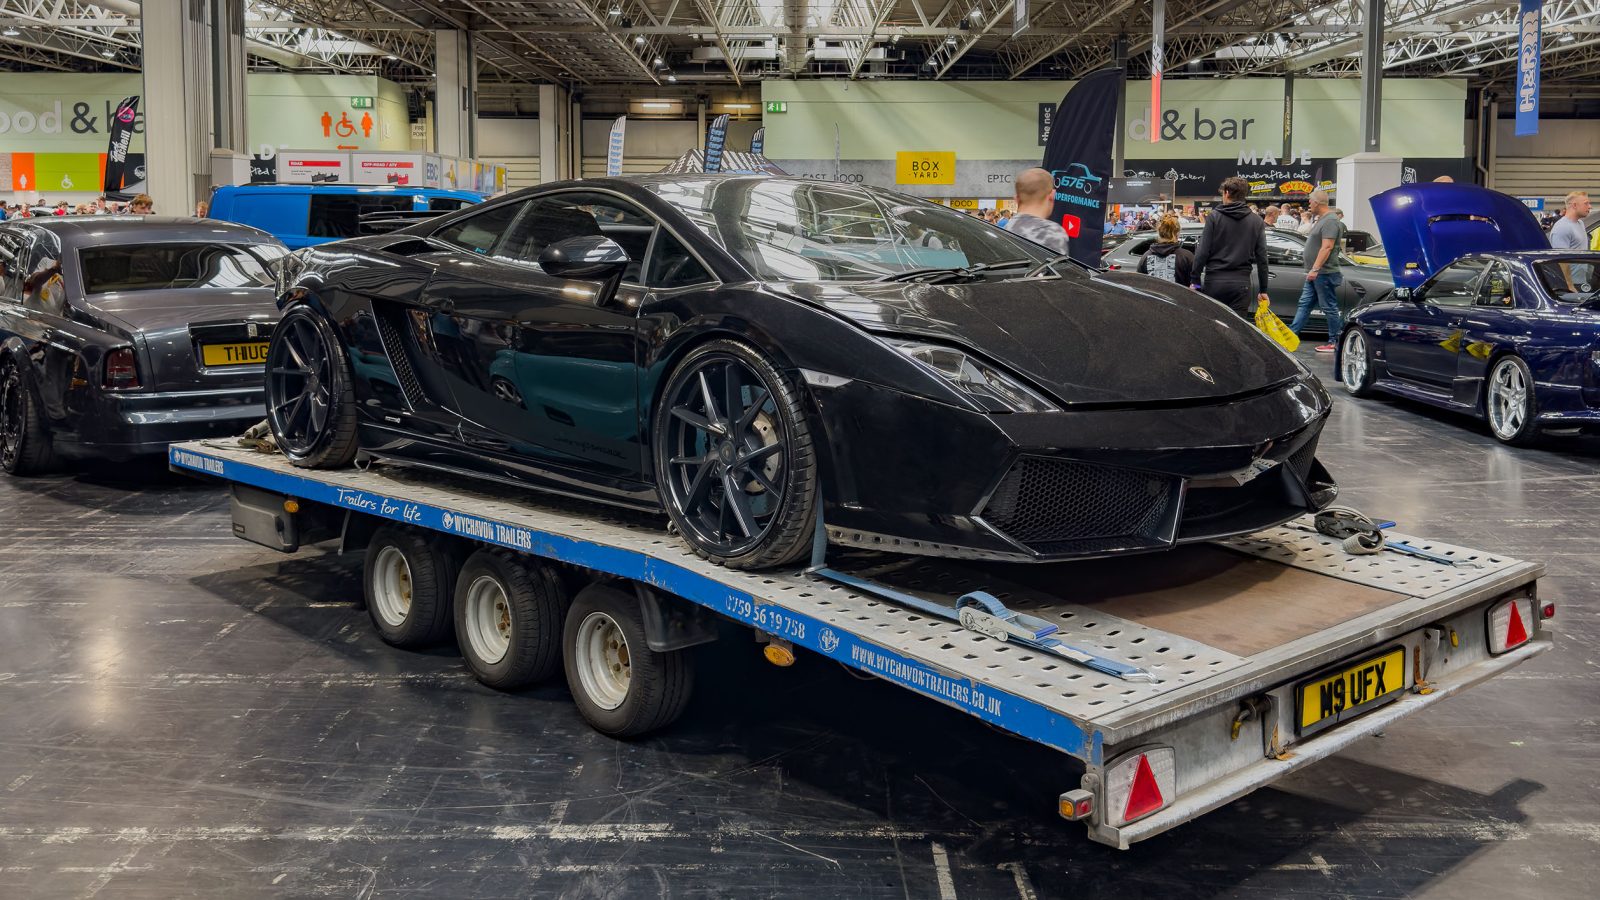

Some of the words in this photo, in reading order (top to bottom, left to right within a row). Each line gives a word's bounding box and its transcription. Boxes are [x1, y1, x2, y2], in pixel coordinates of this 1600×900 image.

[71, 102, 98, 133] &
[1042, 126, 1051, 141] the
[1160, 109, 1187, 141] &
[1194, 108, 1255, 141] bar
[912, 161, 940, 171] BOX
[988, 174, 1011, 183] EPIC
[1061, 176, 1085, 189] 676
[204, 457, 224, 474] TRAILERS
[336, 488, 377, 510] Trailers
[380, 498, 399, 514] for
[403, 504, 421, 521] life
[454, 514, 494, 540] WYCHAVON
[495, 525, 532, 549] TRAILERS
[753, 605, 766, 624] 56
[769, 611, 783, 630] 19
[784, 616, 805, 639] 758
[851, 644, 1002, 717] WWW.WYCHAVONTRAILERS.CO.UK
[1350, 661, 1386, 705] UFX
